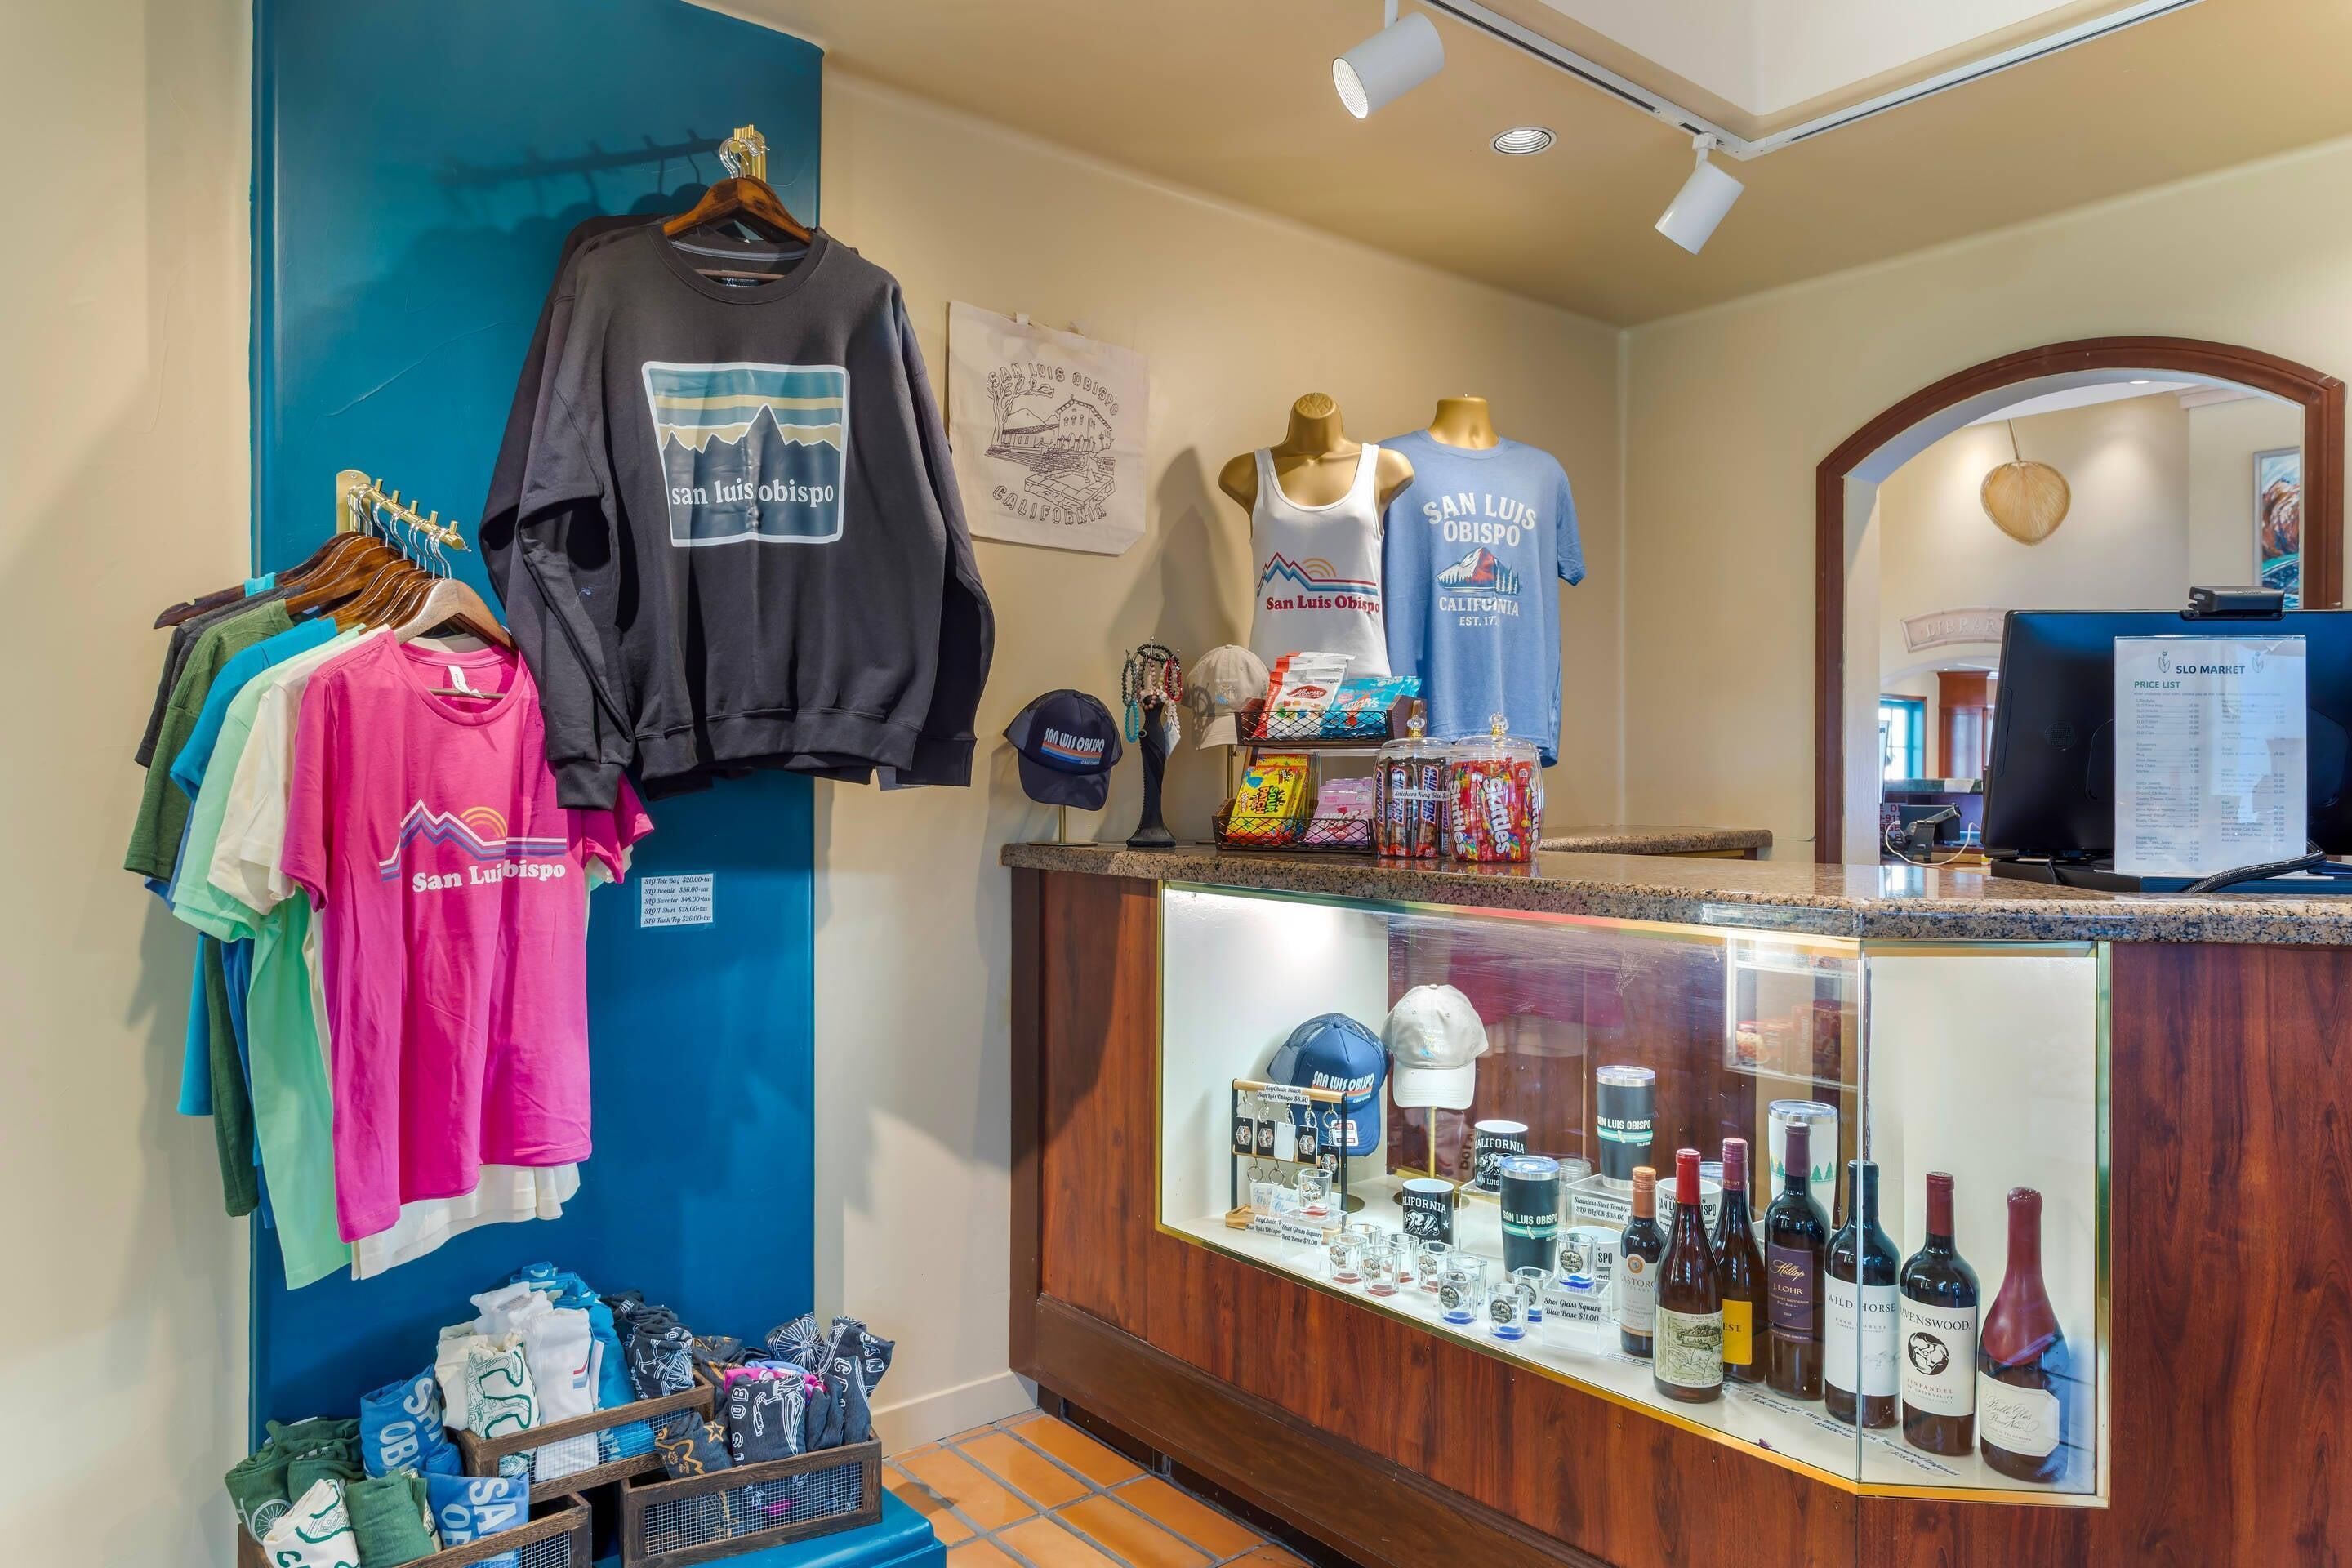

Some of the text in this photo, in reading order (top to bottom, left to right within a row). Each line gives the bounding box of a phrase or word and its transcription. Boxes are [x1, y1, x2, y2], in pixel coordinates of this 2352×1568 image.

[987, 363, 1118, 416] SAN LUIS OBISPO
[672, 478, 834, 507] san luis obispo
[992, 484, 1107, 526] CALIFORNIA
[1423, 492, 1536, 530] SAN LUIS
[1443, 520, 1520, 547] OBISPO
[1267, 595, 1379, 615] San Luis Obispo
[1459, 616, 1481, 626] EST.
[2176, 666, 2246, 675] SLO MARKET
[1044, 728, 1105, 753] SAN LUIS OBISPO
[1255, 786, 1271, 814] PATCH
[1265, 785, 1279, 813] SOUR
[412, 859, 566, 893] San Lui bispo
[1312, 1071, 1375, 1092] SAN LUIS OBISPO
[1607, 1118, 1624, 1129] LUIS
[1626, 1120, 1651, 1130] OBISPO
[1574, 1196, 1630, 1213] Stainless Steel Tumbler
[1503, 1209, 1514, 1223] SAN
[1516, 1214, 1535, 1225] LUIS
[1606, 1211, 1625, 1221] $35.00
[1293, 1227, 1305, 1235] Glass
[1598, 1252, 1613, 1265] SPO
[1770, 1259, 1805, 1281] Hilltop
[1544, 1297, 1601, 1312] Shot Glass Square
[1828, 1292, 1853, 1309] WILD
[1546, 1307, 1599, 1322] Blue Base $11.00
